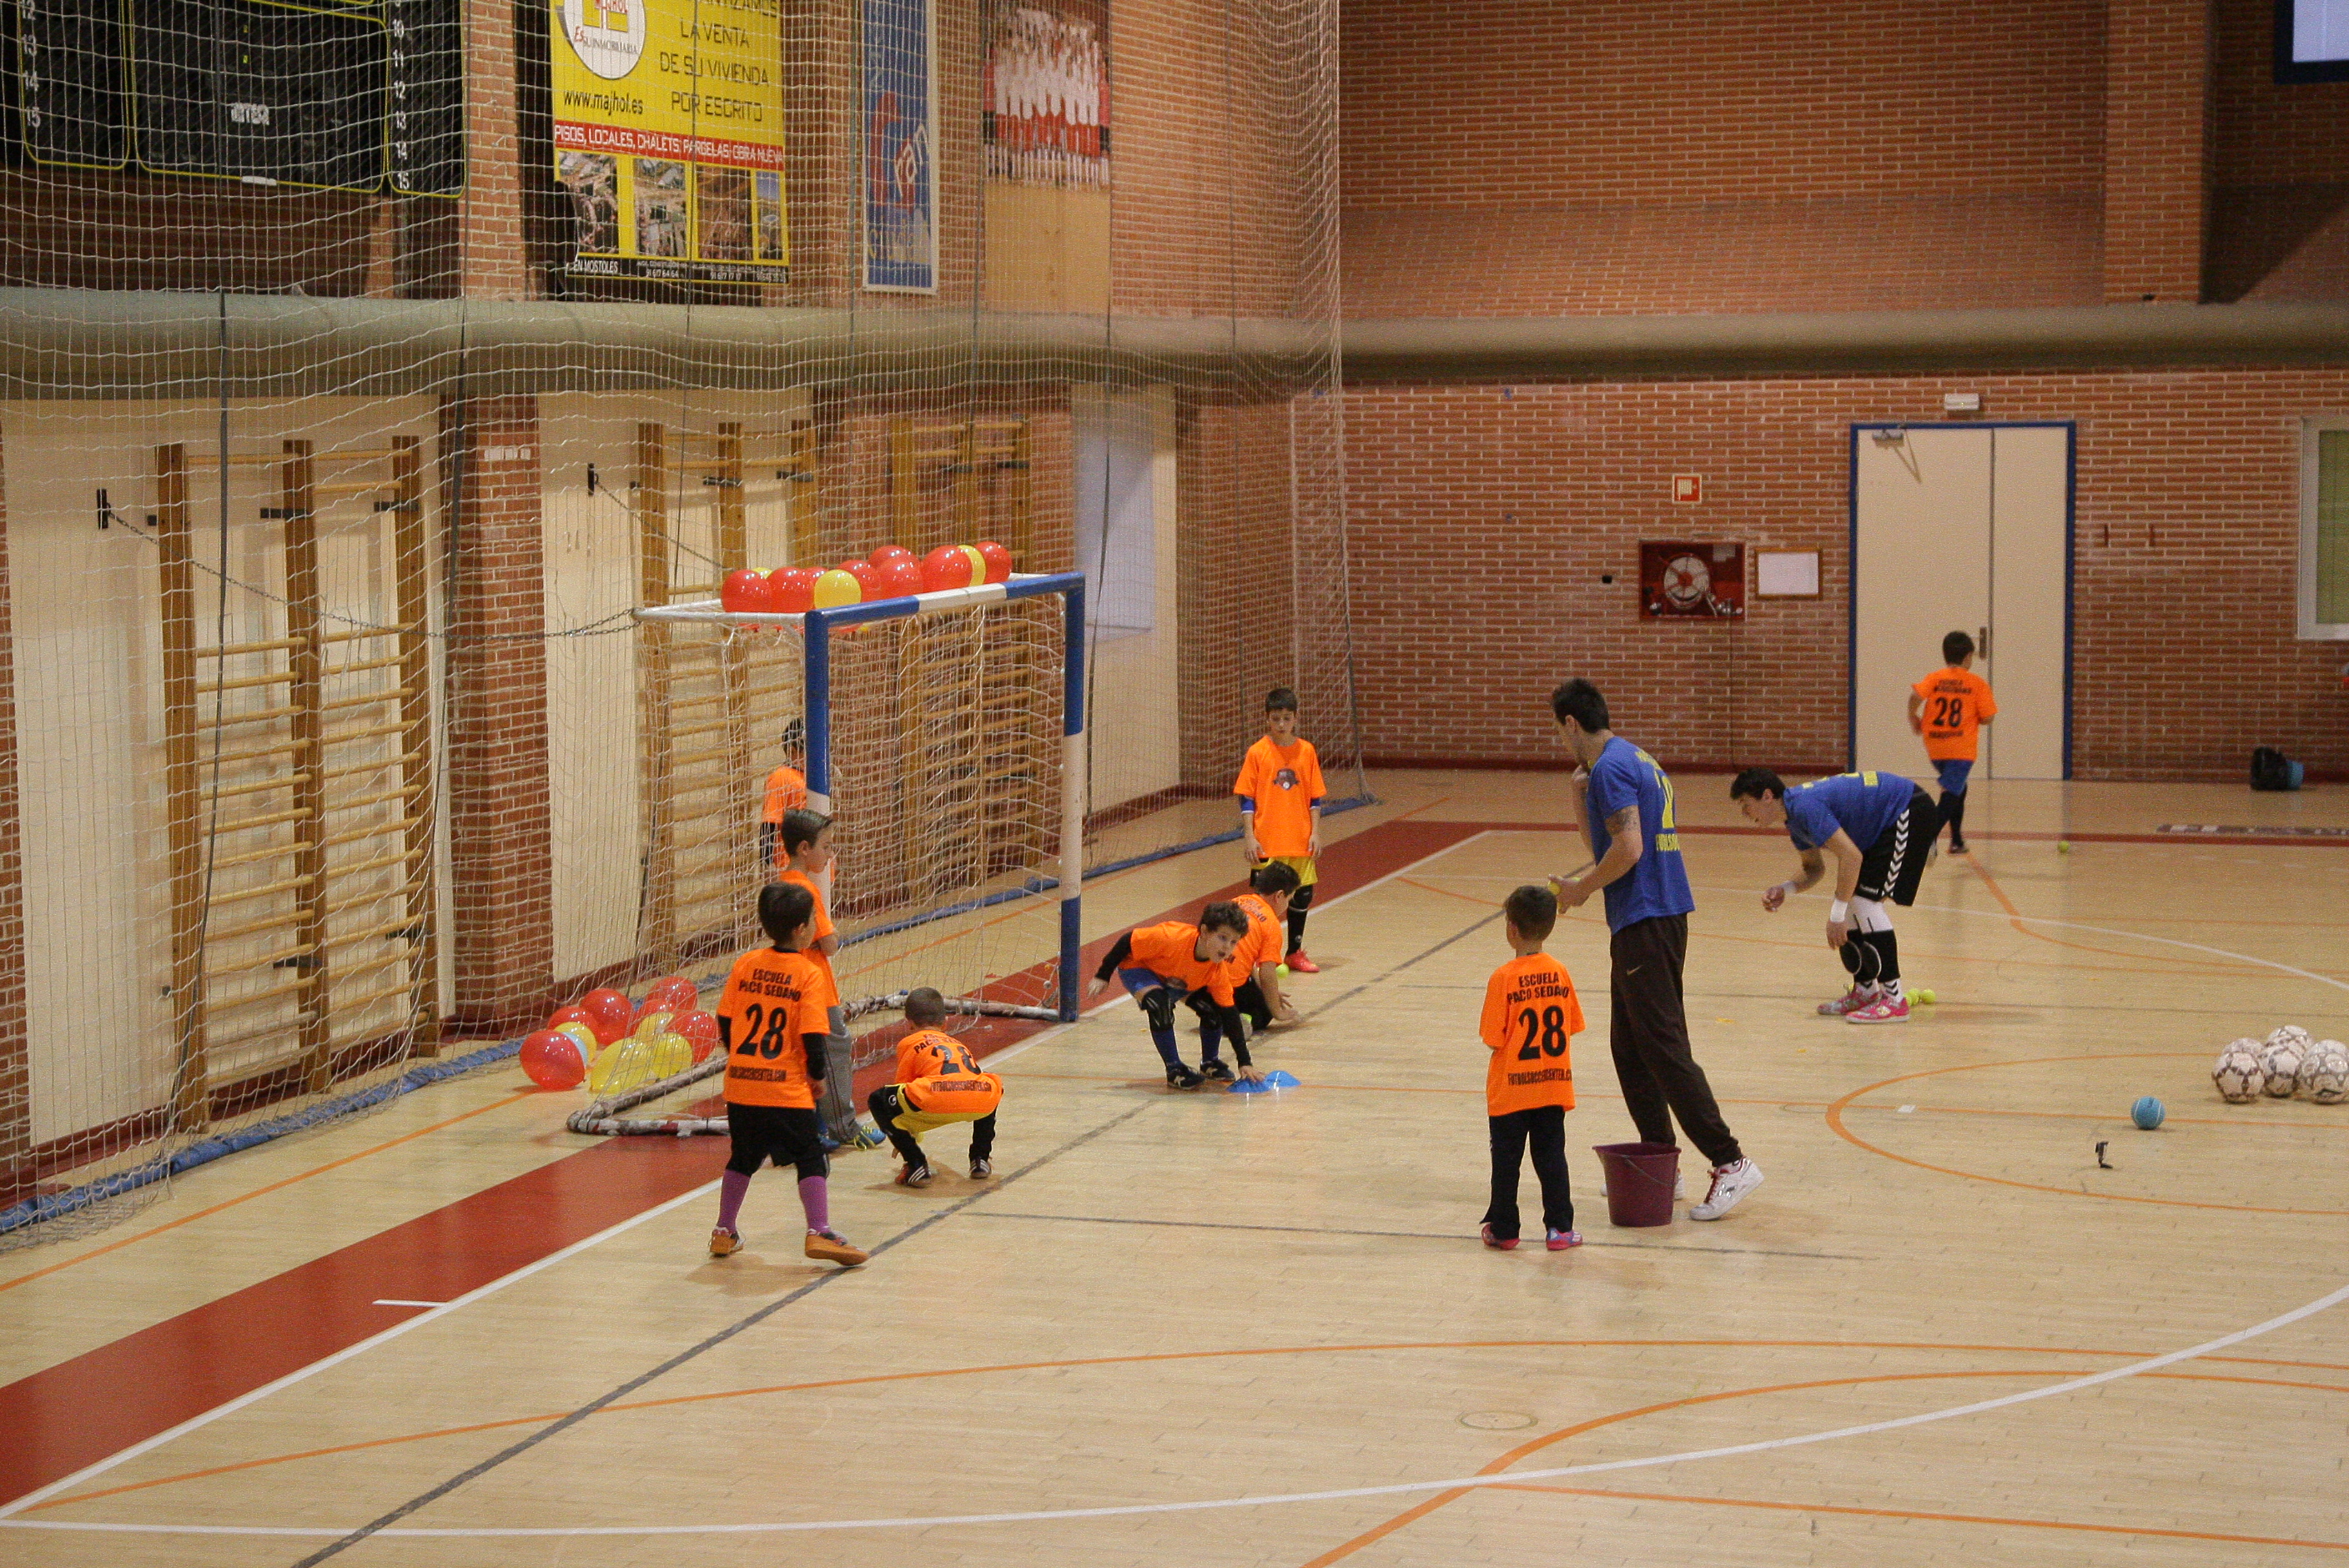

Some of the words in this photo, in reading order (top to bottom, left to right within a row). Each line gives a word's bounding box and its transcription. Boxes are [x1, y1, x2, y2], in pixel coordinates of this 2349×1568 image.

[22, 0, 36, 20] 12
[392, 18, 405, 38] 10
[681, 18, 700, 40] LA
[703, 21, 750, 48] VENTA
[23, 34, 37, 56] 13
[393, 49, 404, 68] 11
[661, 52, 679, 73] DE
[708, 59, 769, 87] VIVIENDA
[24, 70, 38, 92] 14
[394, 80, 406, 99] 12
[564, 90, 644, 116] www.majhol.es
[672, 91, 701, 113] POR
[706, 95, 762, 122] ESCRITO
[27, 107, 40, 128] 15
[395, 111, 406, 130] 13
[554, 124, 586, 145] PISOS,
[588, 128, 636, 149] LOCALES,
[395, 142, 407, 160] 14
[397, 172, 410, 190] 15
[1934, 696, 1963, 728] 28
[752, 968, 792, 985] ESCUELA
[1518, 971, 1559, 988] ESCUELA
[738, 979, 763, 994] PACO
[765, 984, 802, 1002] SEDANO
[1506, 988, 1532, 1005] PACO
[736, 1003, 787, 1060] 28
[1518, 1005, 1567, 1061] 28
[931, 1044, 983, 1076] 28
